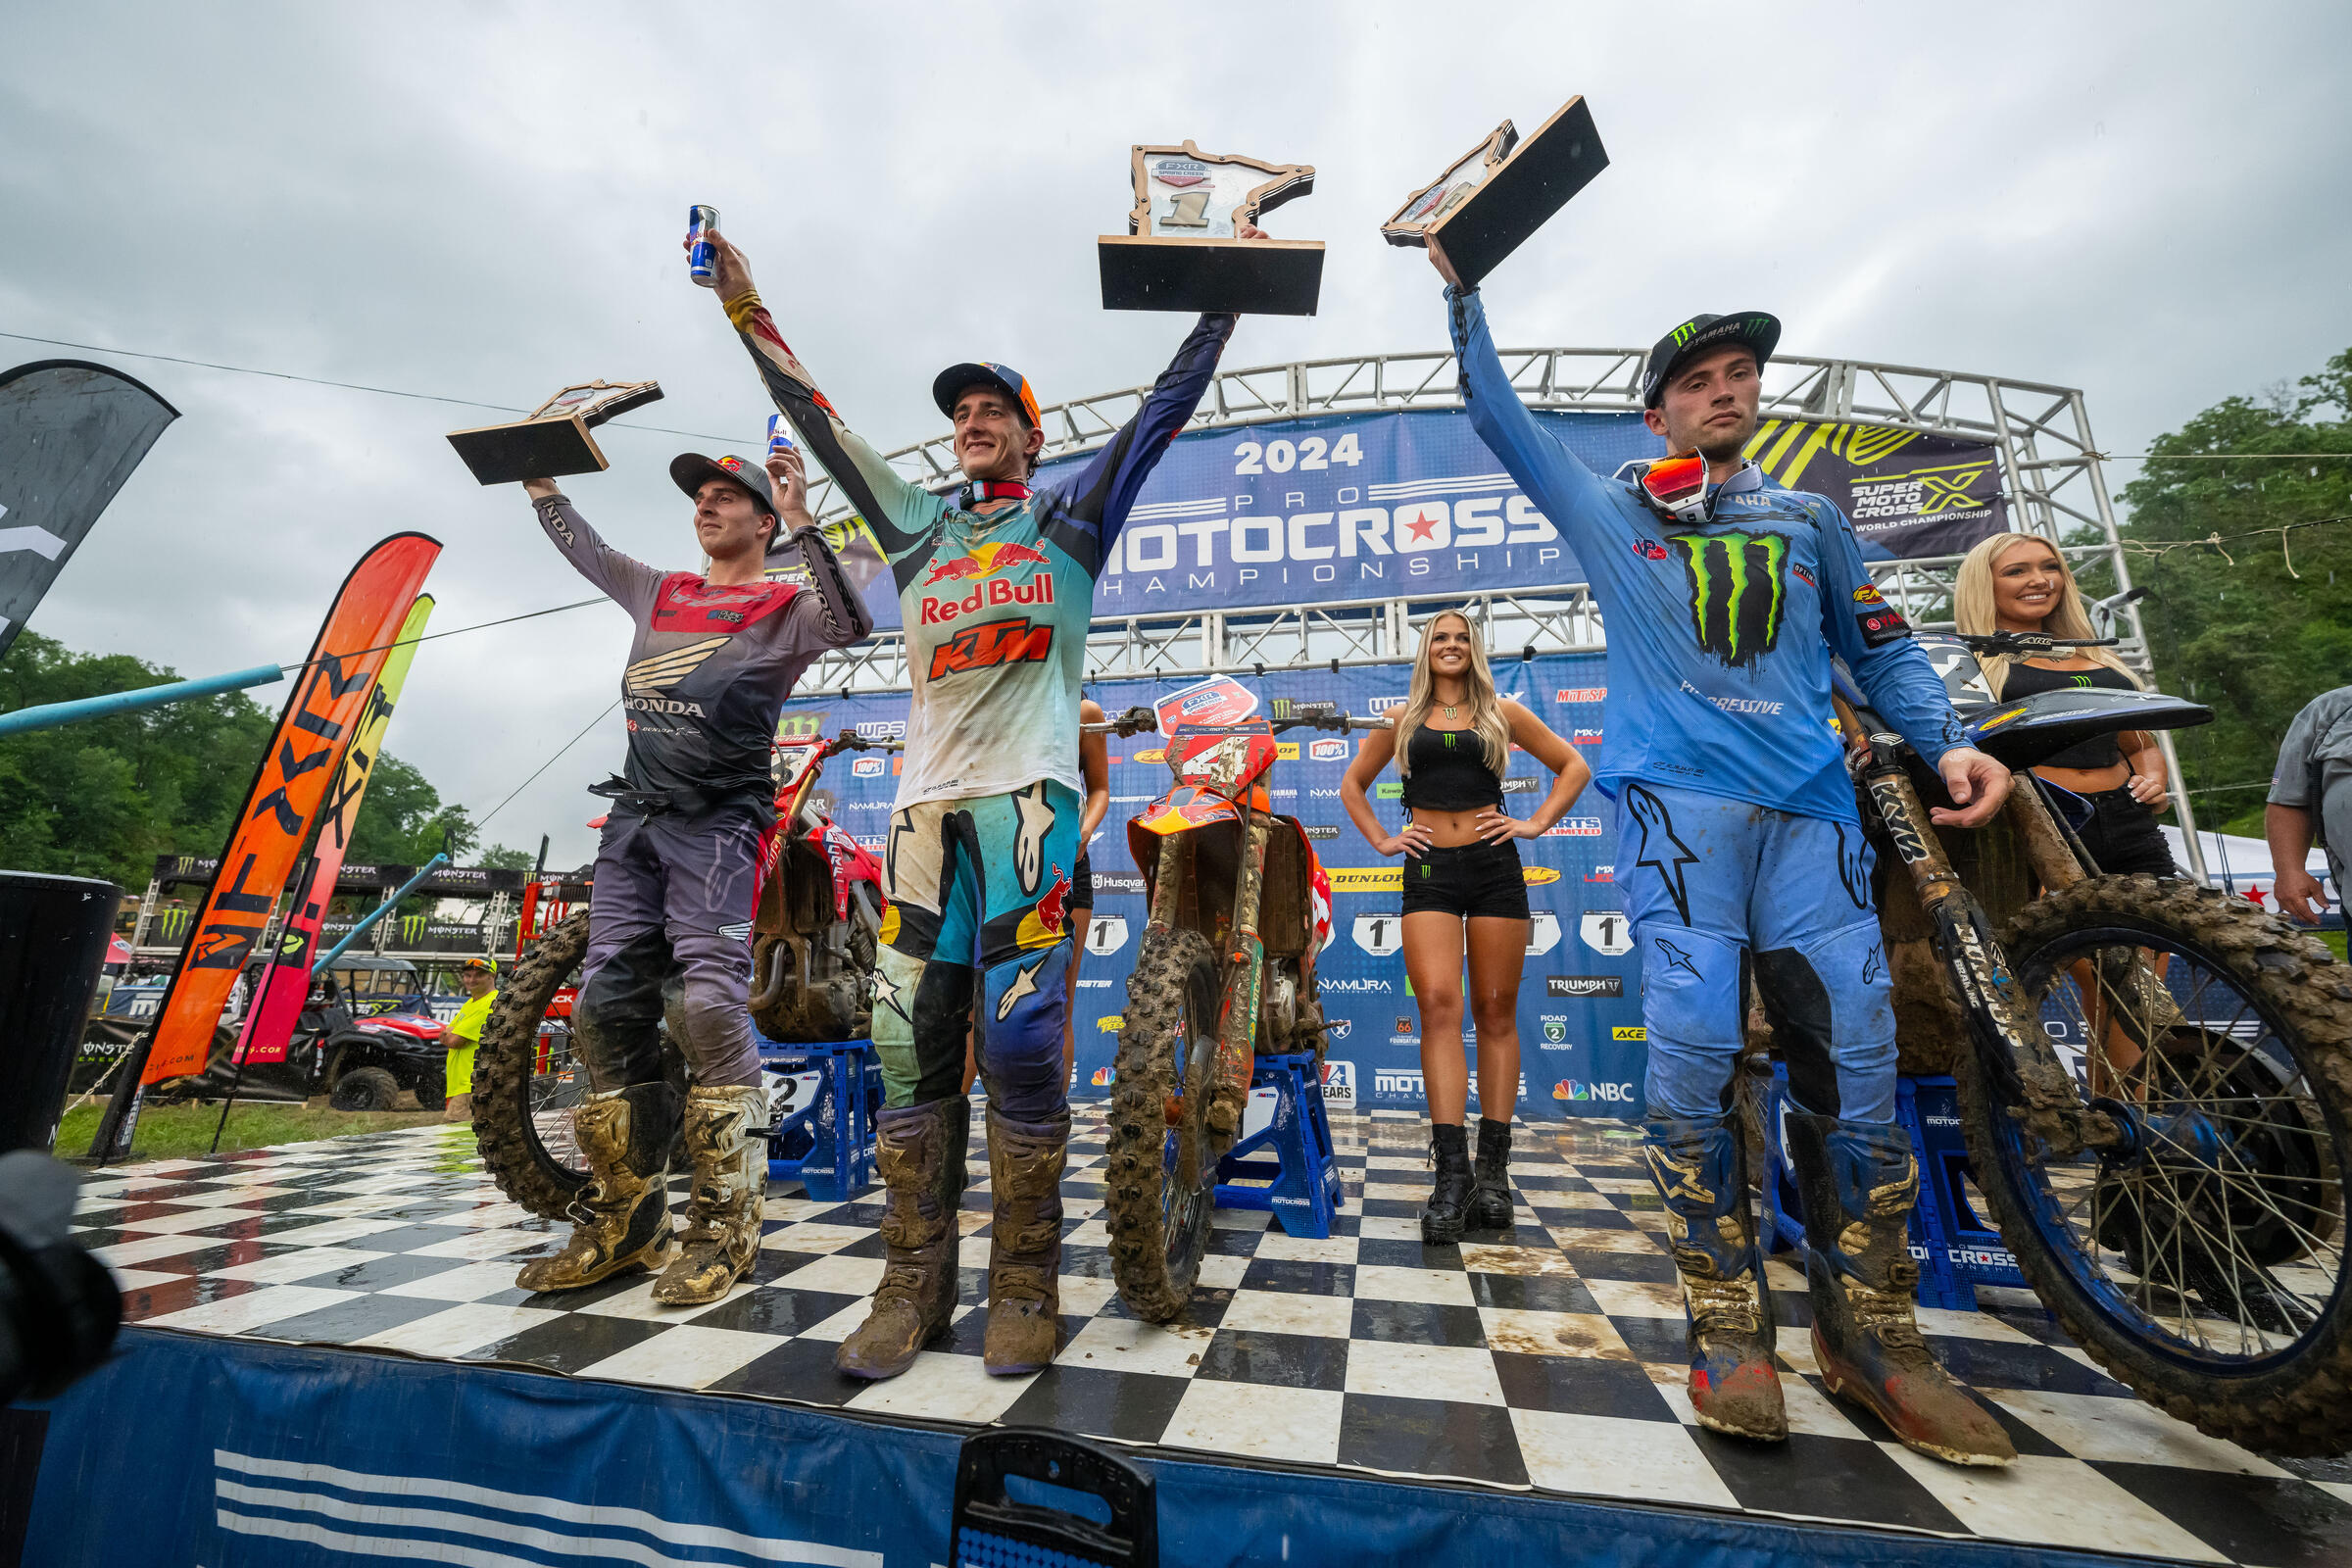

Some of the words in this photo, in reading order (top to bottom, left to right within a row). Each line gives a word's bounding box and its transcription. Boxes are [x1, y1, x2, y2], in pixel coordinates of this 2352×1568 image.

[1165, 162, 1200, 171] FXR
[1694, 321, 1740, 346] YAMAHA
[1233, 433, 1364, 475] 2024
[1851, 480, 1924, 498] SUPER
[1235, 486, 1359, 511] PRO
[1855, 493, 1922, 509] MOTO
[1851, 503, 1925, 519] CROSS
[1855, 521, 1896, 532] WORLD
[1900, 510, 1992, 528] CHAMPIONSHIP
[1102, 547, 1560, 597] HAMPIONSHIP
[921, 582, 984, 625] Red
[988, 572, 1055, 606] Bull
[927, 616, 1054, 683] KTM
[624, 696, 706, 718] HONDA
[1186, 692, 1215, 707] FXR
[856, 721, 906, 738] WPS
[1314, 743, 1345, 756] 100%
[856, 761, 881, 773] 100%
[1181, 735, 1253, 784] 4
[431, 869, 487, 880] MONSTER
[427, 926, 477, 935] MONSTER
[1316, 978, 1393, 990] NAMURA
[1548, 980, 1606, 994] TRIUMPH
[1098, 1015, 1124, 1026] MOTO
[1397, 1022, 1412, 1033] 66
[1549, 1028, 1560, 1040] 2
[1323, 1086, 1351, 1099] EARS
[1590, 1082, 1635, 1102] NBC
[1271, 1197, 1311, 1206] MOTOCROSS
